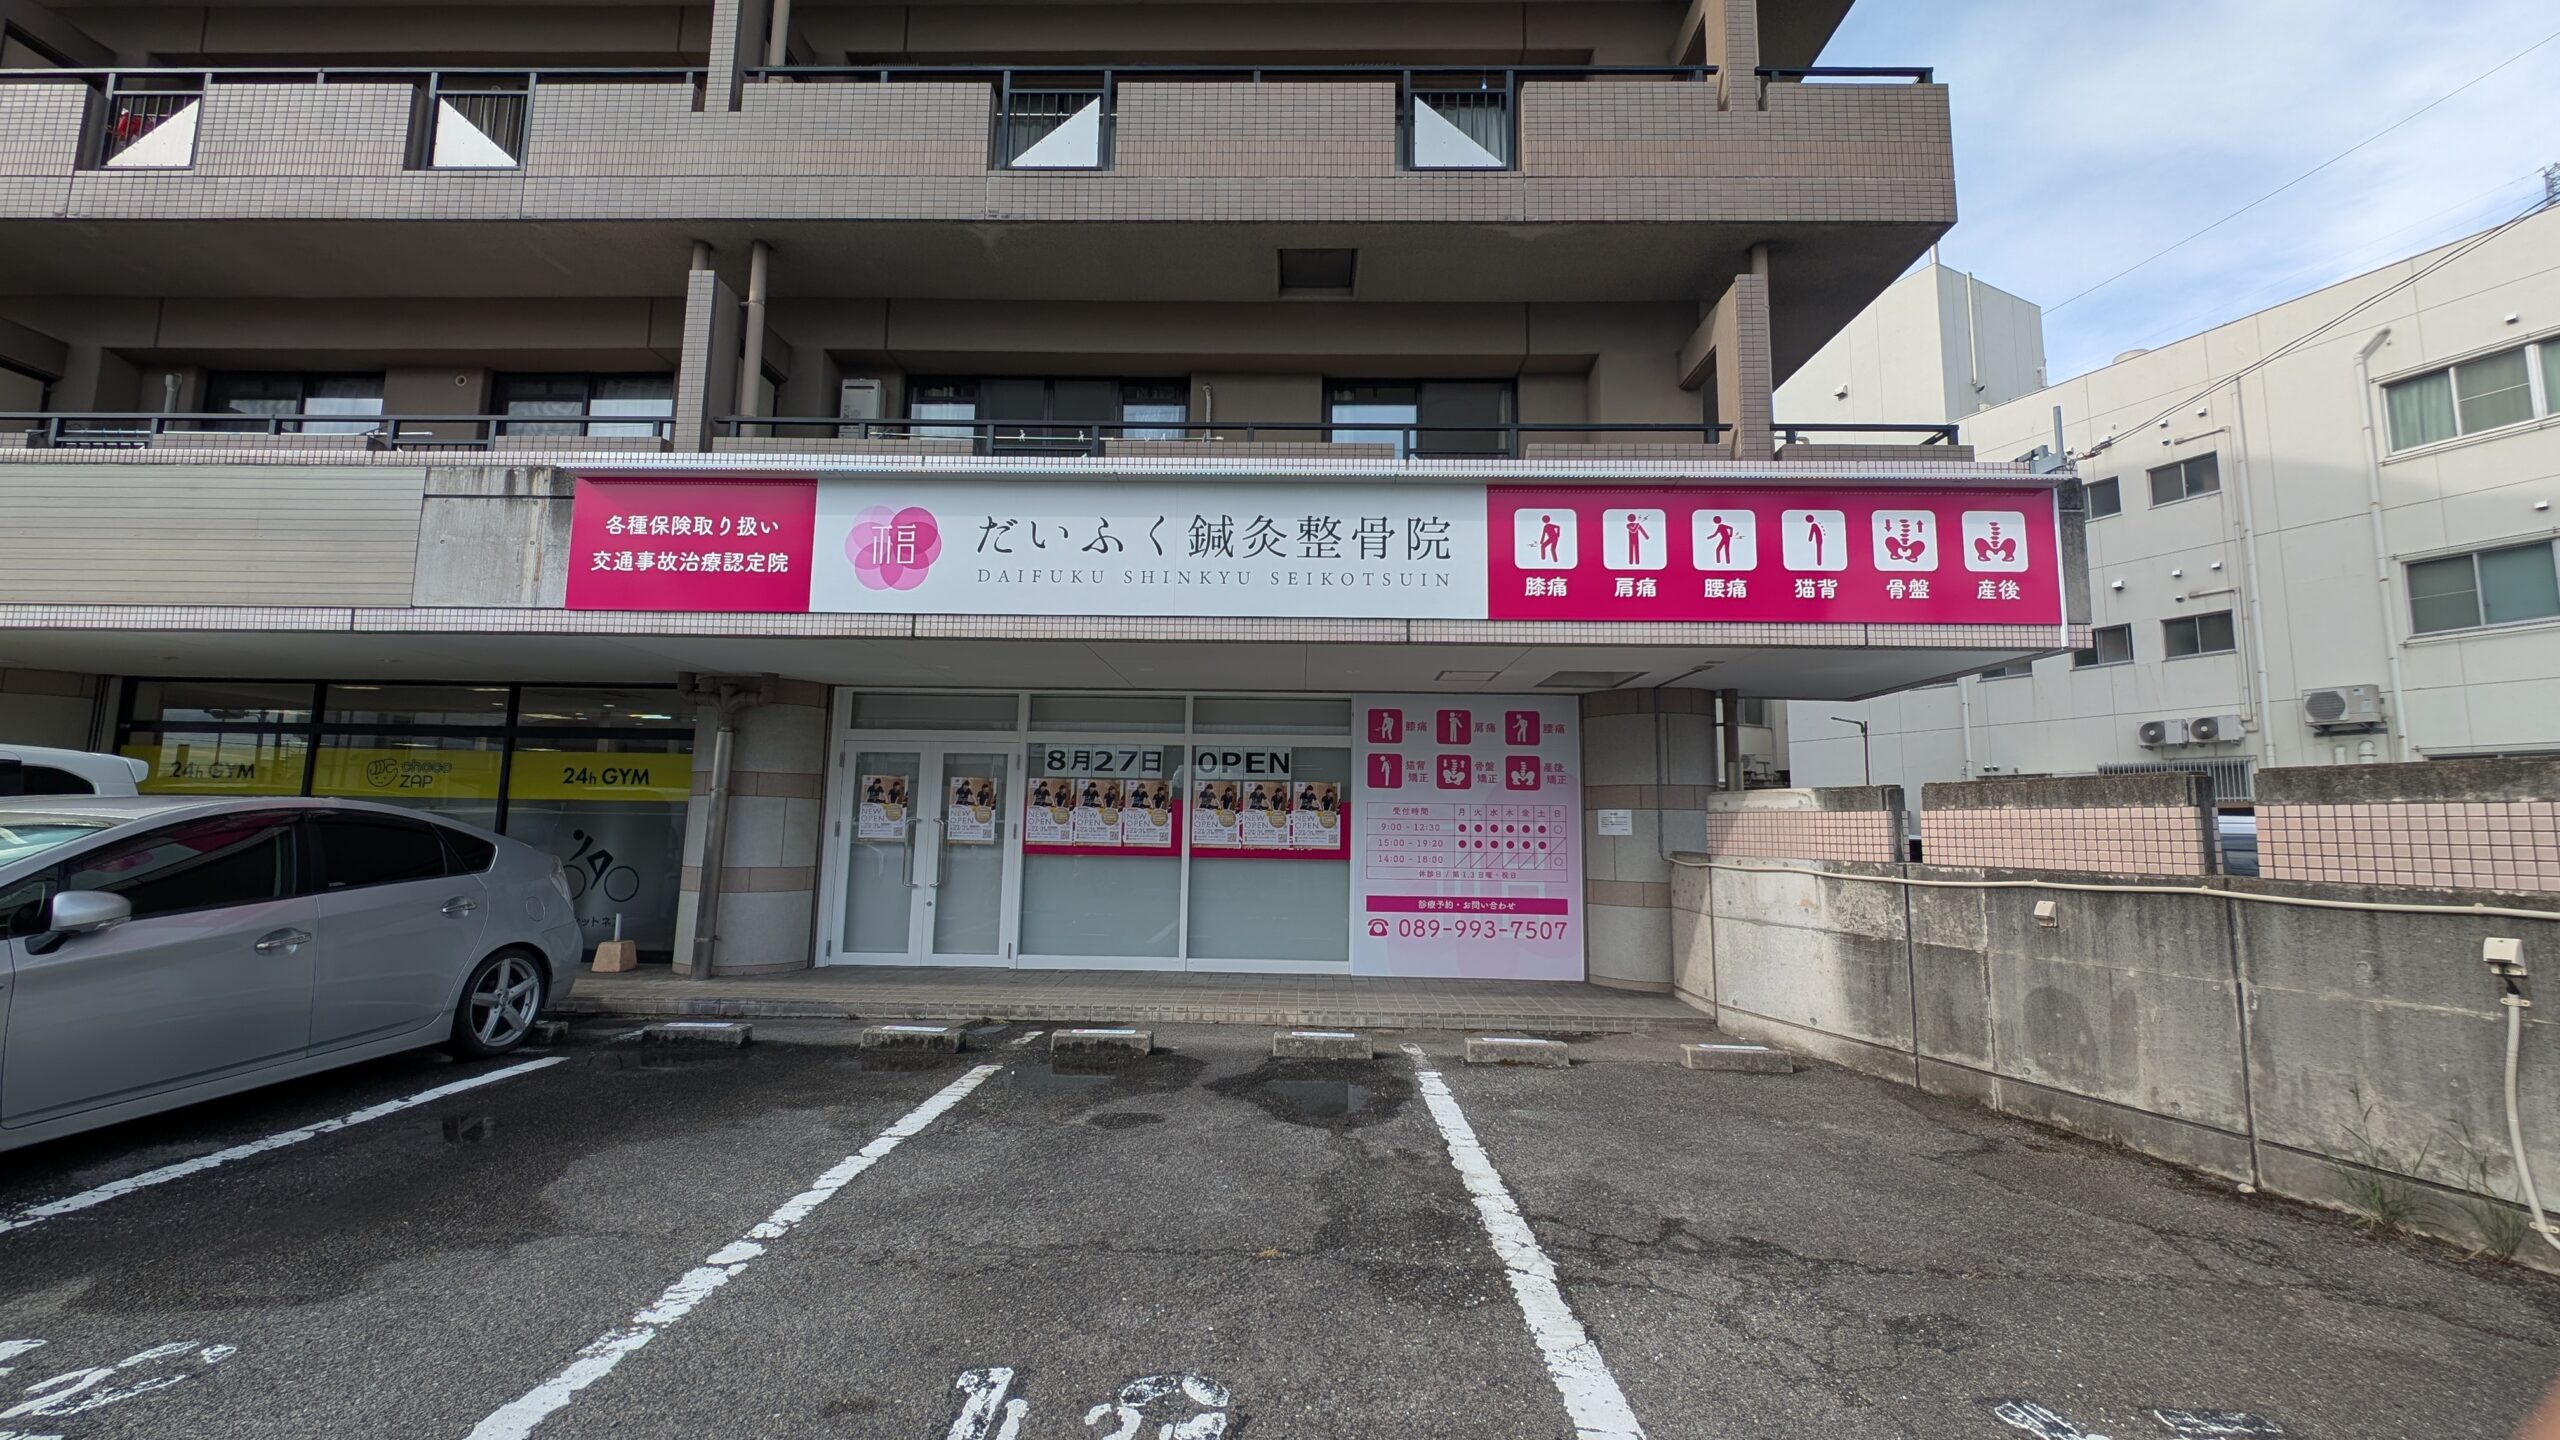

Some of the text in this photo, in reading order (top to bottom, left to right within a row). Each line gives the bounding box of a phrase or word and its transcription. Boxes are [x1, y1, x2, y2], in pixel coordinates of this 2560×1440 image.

[605, 515, 779, 537] 各種保険取り扱い
[976, 514, 1451, 561] だいふく鍼灸整骨院
[590, 550, 789, 574] 交通事故治療認定院
[977, 568, 1451, 587] DAIFUKU SHINKYU SEIKOTSUIN
[1524, 577, 1568, 597] 膝痛
[1614, 578, 1657, 598] 肩痛
[1704, 578, 1747, 599] 腰痛
[1794, 578, 1838, 599] 猫背
[1886, 579, 1930, 600] 骨盤
[1976, 580, 2021, 601] 産後
[169, 761, 255, 779] 24h GYM
[1047, 750, 1161, 773] 8月27日
[1198, 751, 1290, 774] OPEN
[399, 774, 433, 789] ZAP
[563, 767, 650, 785] 24h GYM
[950, 817, 974, 825] OPEN
[1457, 808, 1465, 816] 月
[1473, 808, 1482, 816] 火
[1489, 808, 1498, 817] 水
[1505, 808, 1514, 817] 木
[1521, 809, 1530, 817] 金
[1537, 809, 1545, 818] 土
[1554, 809, 1560, 818] 日
[1380, 823, 1402, 831] 9:00
[1414, 823, 1441, 832] 12:30
[1418, 899, 1516, 910] 診療予約・お問い合わせ
[1398, 918, 1568, 940] 089-993-7507
